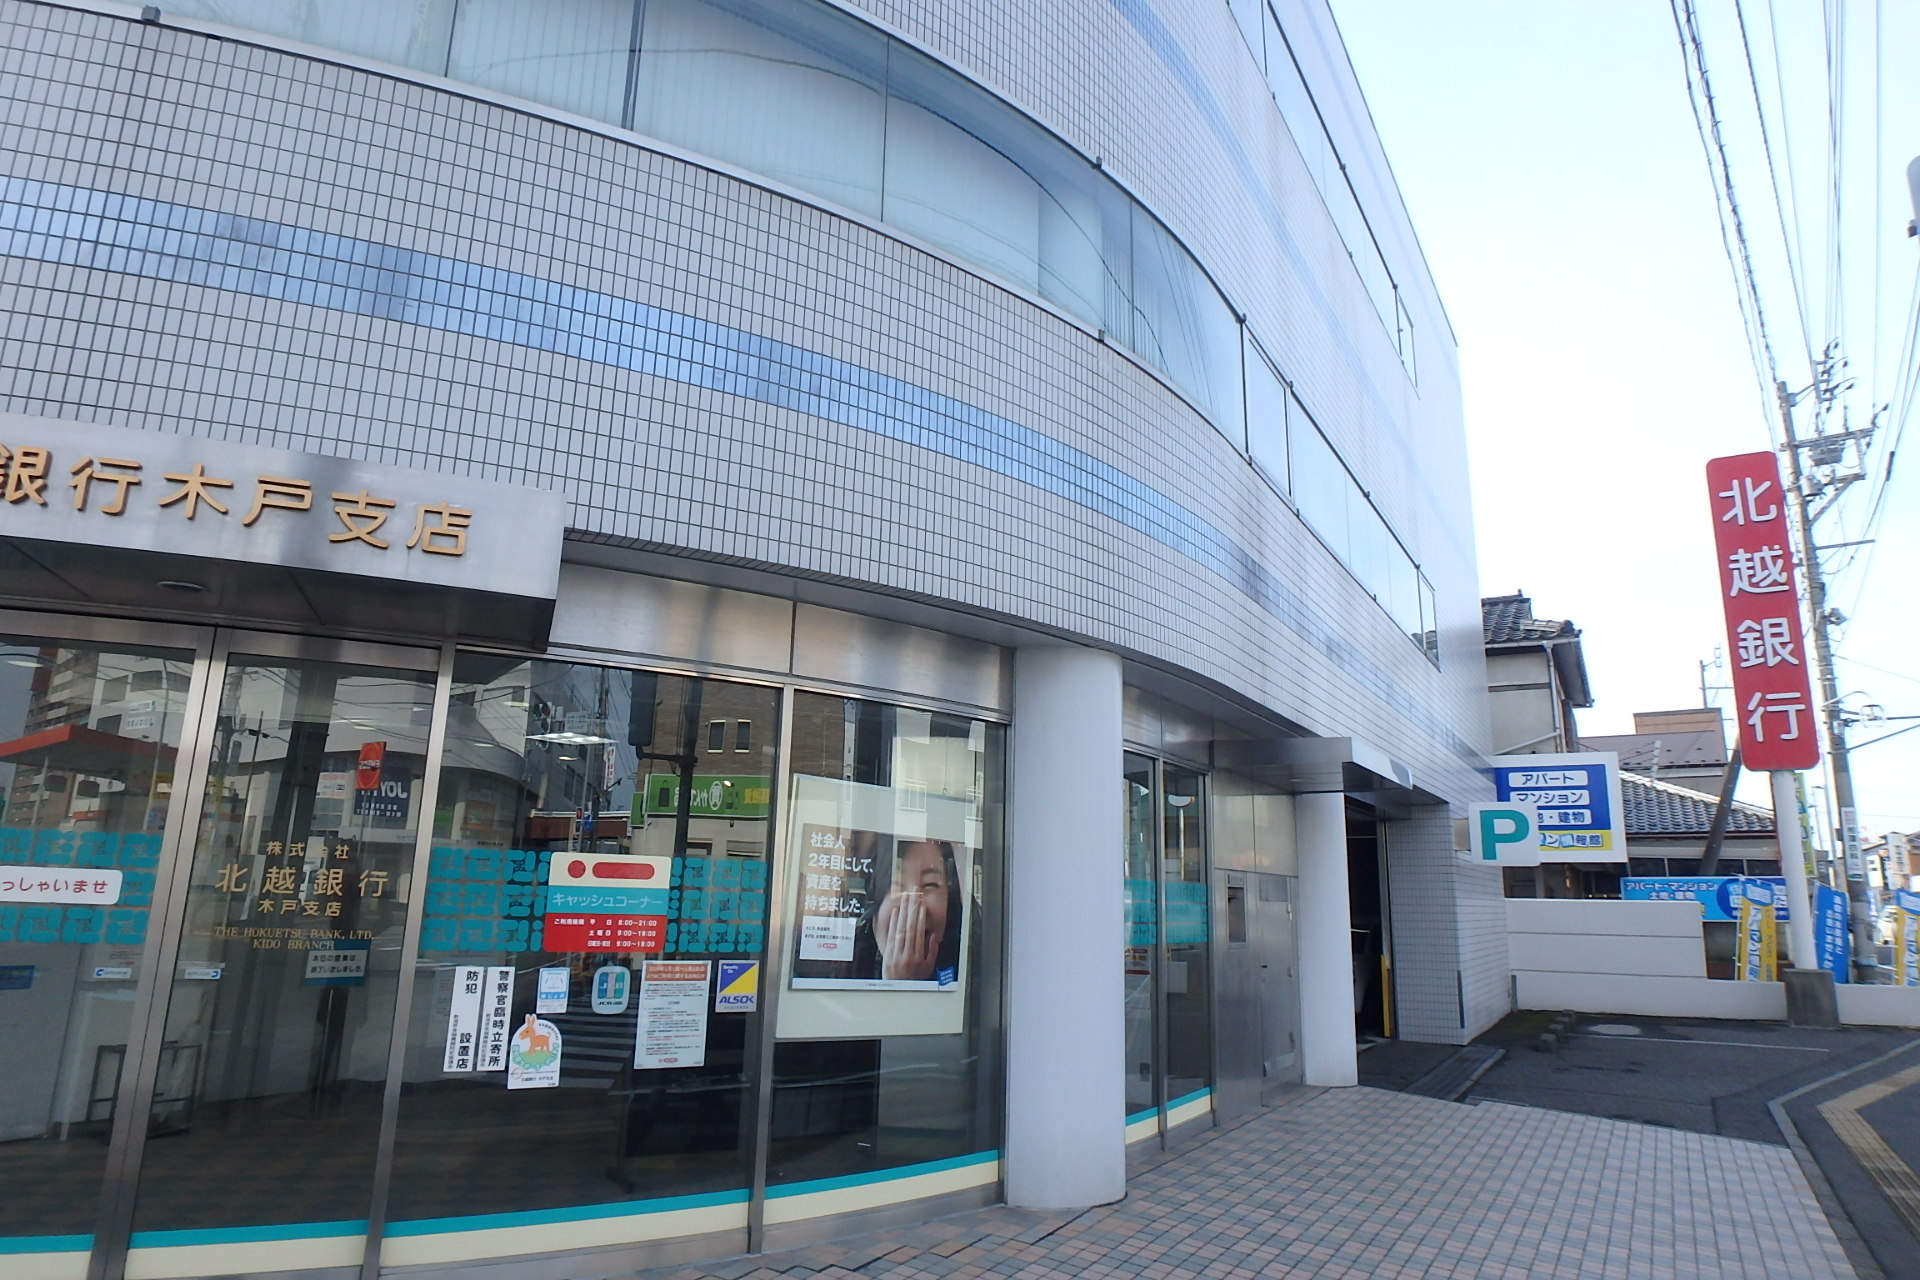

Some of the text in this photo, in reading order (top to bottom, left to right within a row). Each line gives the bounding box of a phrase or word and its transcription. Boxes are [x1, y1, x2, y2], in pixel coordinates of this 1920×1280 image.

[0, 444, 473, 556] 銀行木戸支店
[1719, 477, 1807, 743] 北越銀行
[1516, 791, 1583, 804] マンション
[810, 831, 846, 849] 社会人
[1479, 809, 1530, 861] P
[266, 840, 350, 859] 株式会社
[807, 853, 874, 873] 2年目にして、
[2, 877, 108, 894] っしゃいませ
[215, 863, 389, 898] 北越銀行
[805, 873, 842, 891] 資産を
[257, 898, 343, 917] 木戸支店
[552, 892, 663, 908] キャッシュコーナー
[804, 895, 866, 914] 持ちました。
[215, 926, 240, 937] THE
[244, 926, 306, 939] HOKUETSU
[253, 939, 335, 950] KIDO BRANCH
[718, 995, 755, 1005] ALSOK
[456, 970, 480, 1069] 防犯 設置店
[488, 970, 510, 1067] 警察官臨時立寄所
